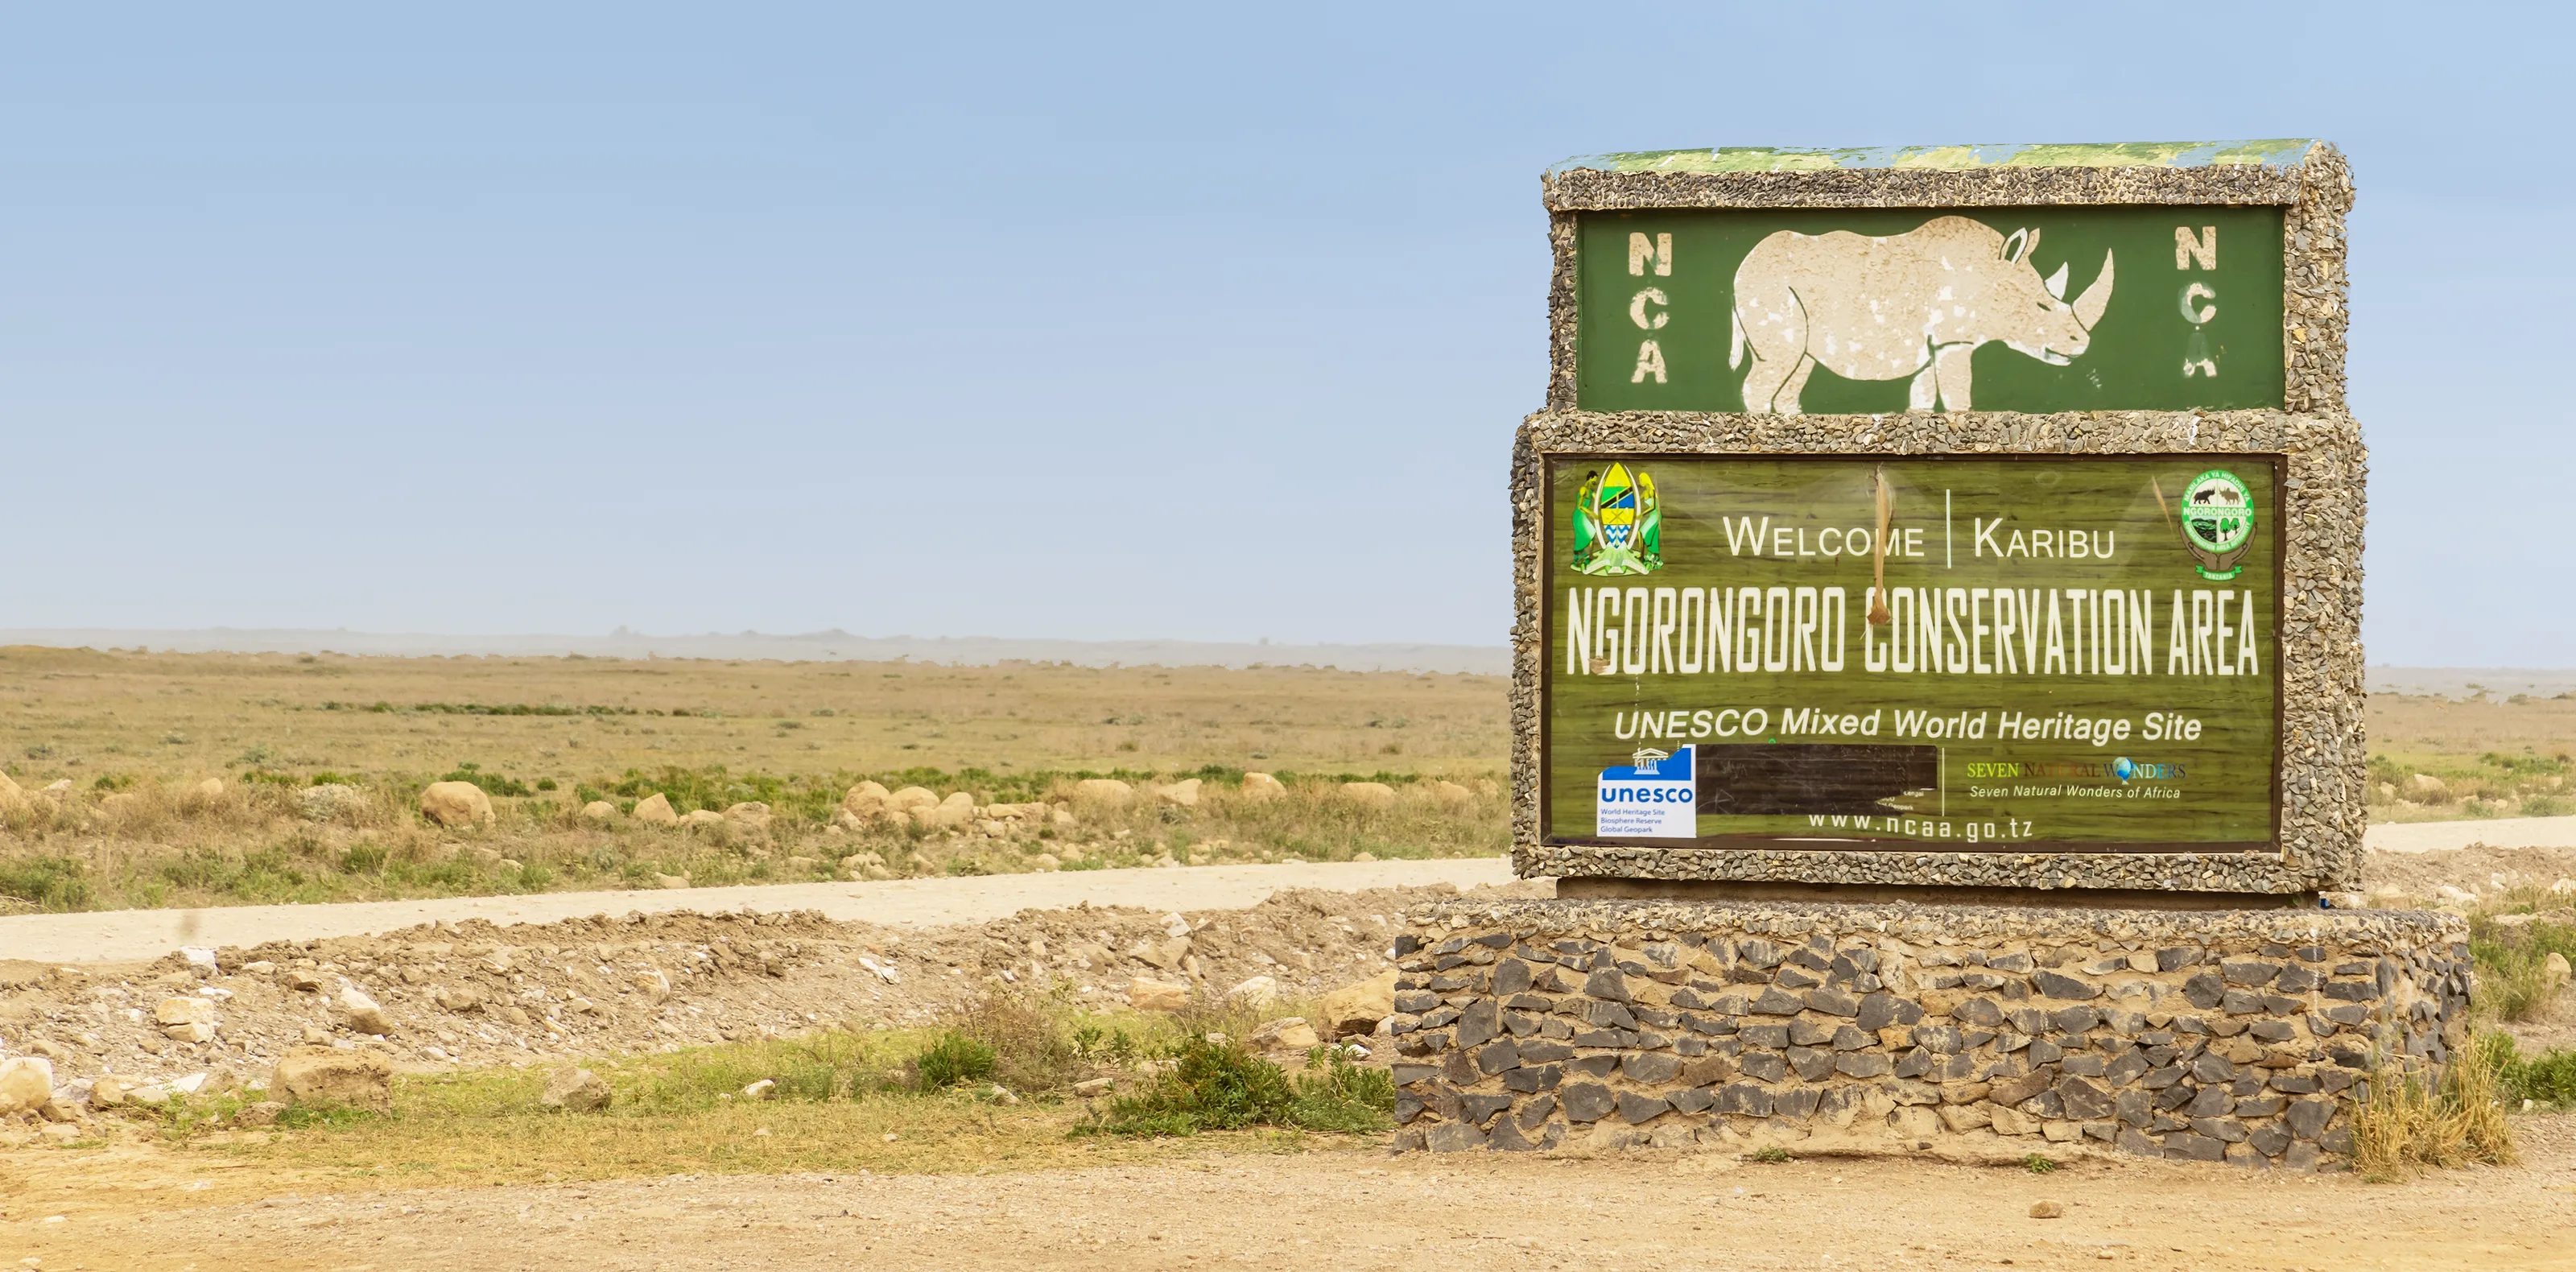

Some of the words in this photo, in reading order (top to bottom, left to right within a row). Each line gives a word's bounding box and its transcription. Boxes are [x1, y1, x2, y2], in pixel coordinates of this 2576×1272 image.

[2182, 506, 2252, 517] NGORONGORO
[1567, 587, 1845, 675] NGORONGORO
[1865, 587, 2153, 675] CONSERVATION
[2168, 589, 2260, 675] AREA
[1614, 708, 1768, 740] UNESCO
[1781, 708, 1881, 735] Mixed
[1894, 709, 1987, 739] World
[1997, 712, 2131, 746] Heritage
[2142, 712, 2202, 741] Site
[1967, 762, 2019, 778] SEVEN
[1602, 788, 1693, 803] unesco
[1970, 786, 2008, 798] Seven
[2013, 785, 2062, 796] Natural
[2066, 786, 2123, 798] Wonders
[2128, 787, 2140, 798] of
[2143, 787, 2181, 799] Africa
[1623, 809, 1651, 817] Heritage
[1601, 817, 1634, 825] Biosphere
[1809, 815, 2033, 843] www.ncaa.go.tz
